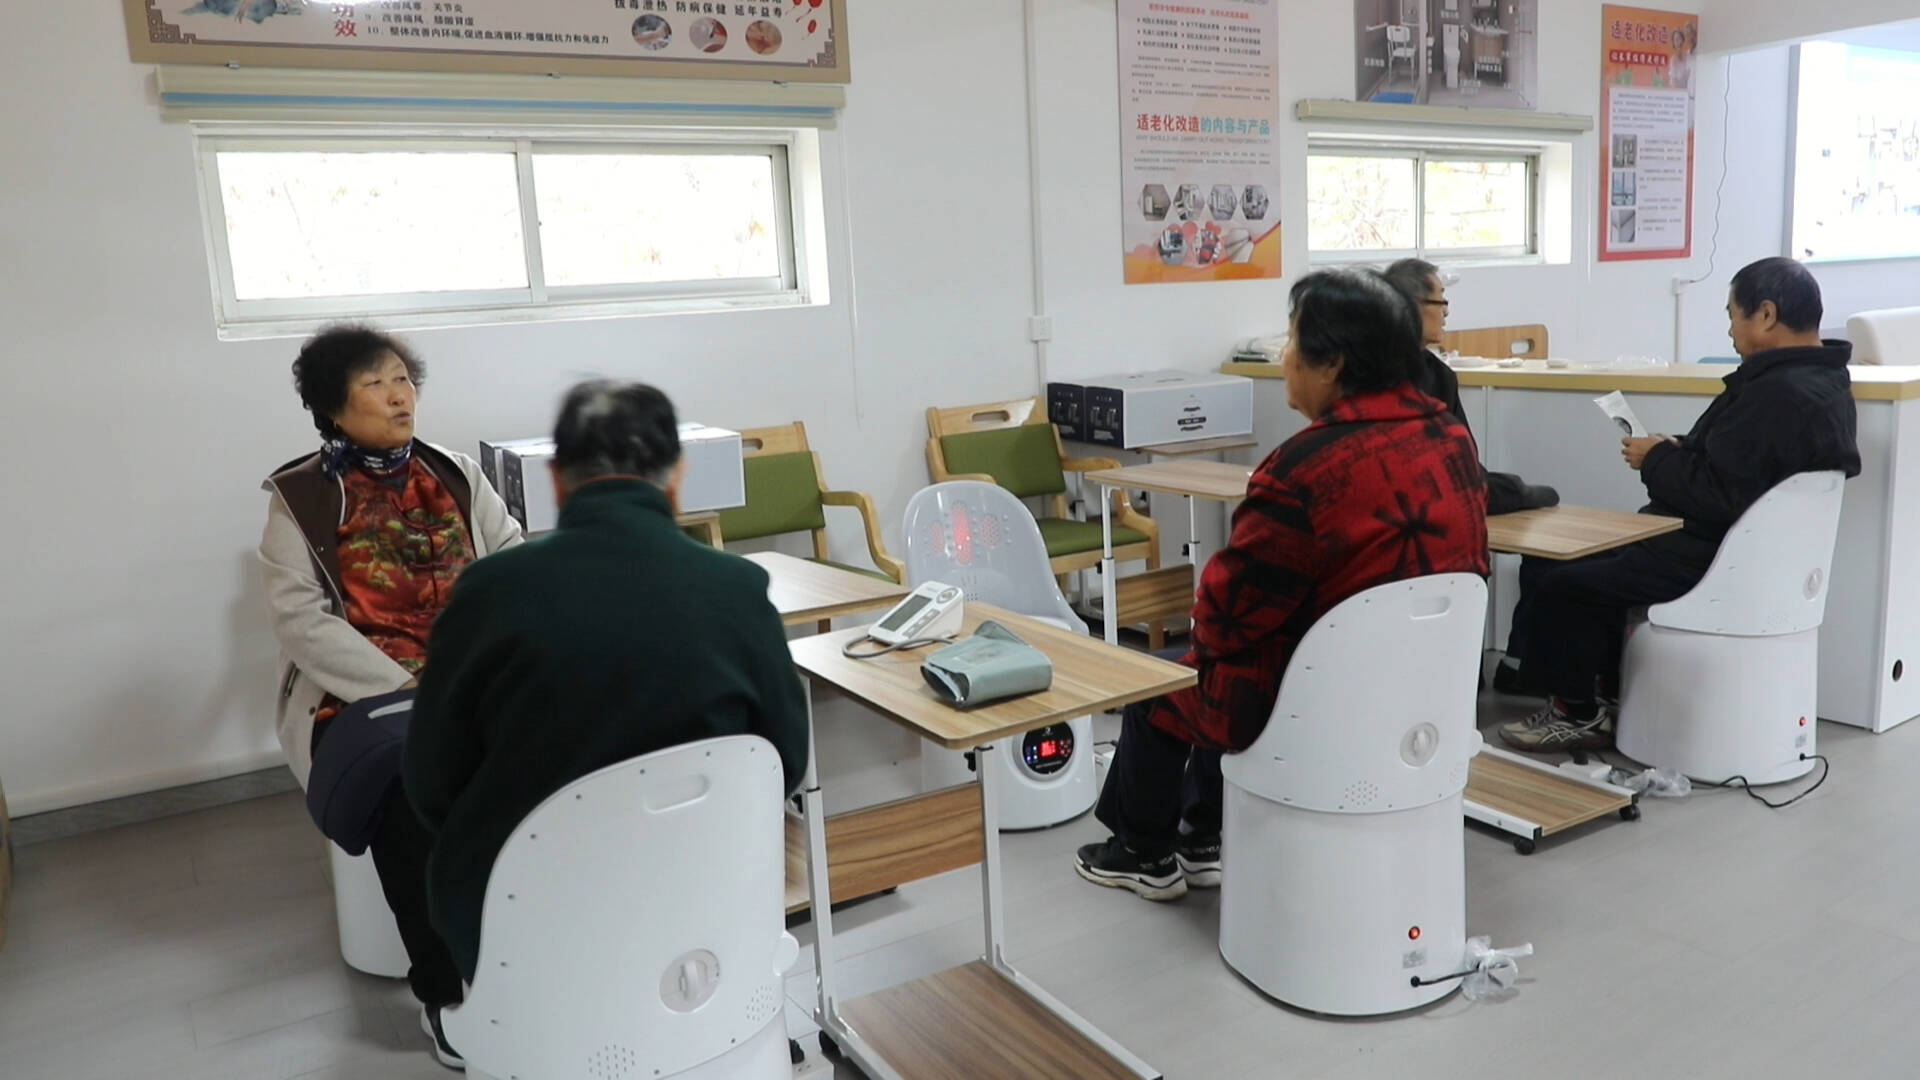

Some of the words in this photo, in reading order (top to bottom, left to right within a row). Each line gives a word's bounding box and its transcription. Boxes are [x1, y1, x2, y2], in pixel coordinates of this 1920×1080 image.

[676, 1, 726, 15] 防病保健
[735, 5, 782, 18] 延年益寿
[1137, 113, 1270, 135] 适老化改造的内容与产品
